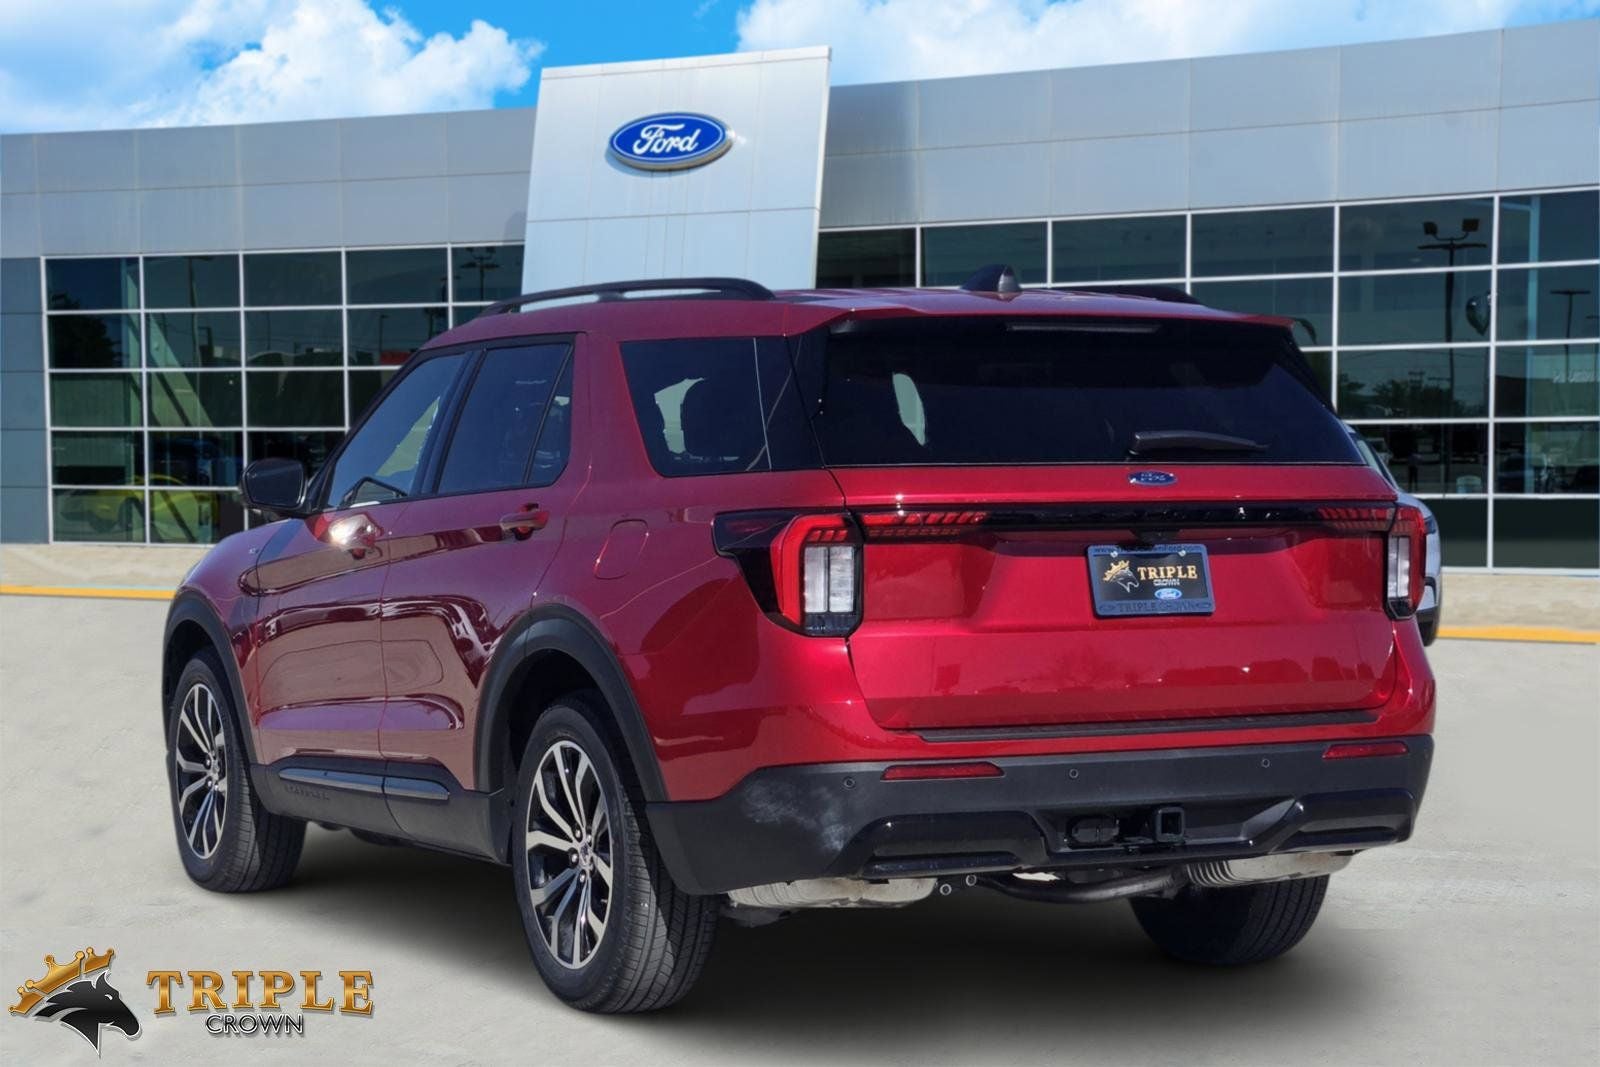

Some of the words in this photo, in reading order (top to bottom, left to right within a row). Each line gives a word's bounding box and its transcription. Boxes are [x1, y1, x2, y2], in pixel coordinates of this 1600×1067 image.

[632, 123, 701, 155] Ford
[1137, 565, 1198, 580] TRIPLE
[1119, 601, 1156, 612] TRIPLE
